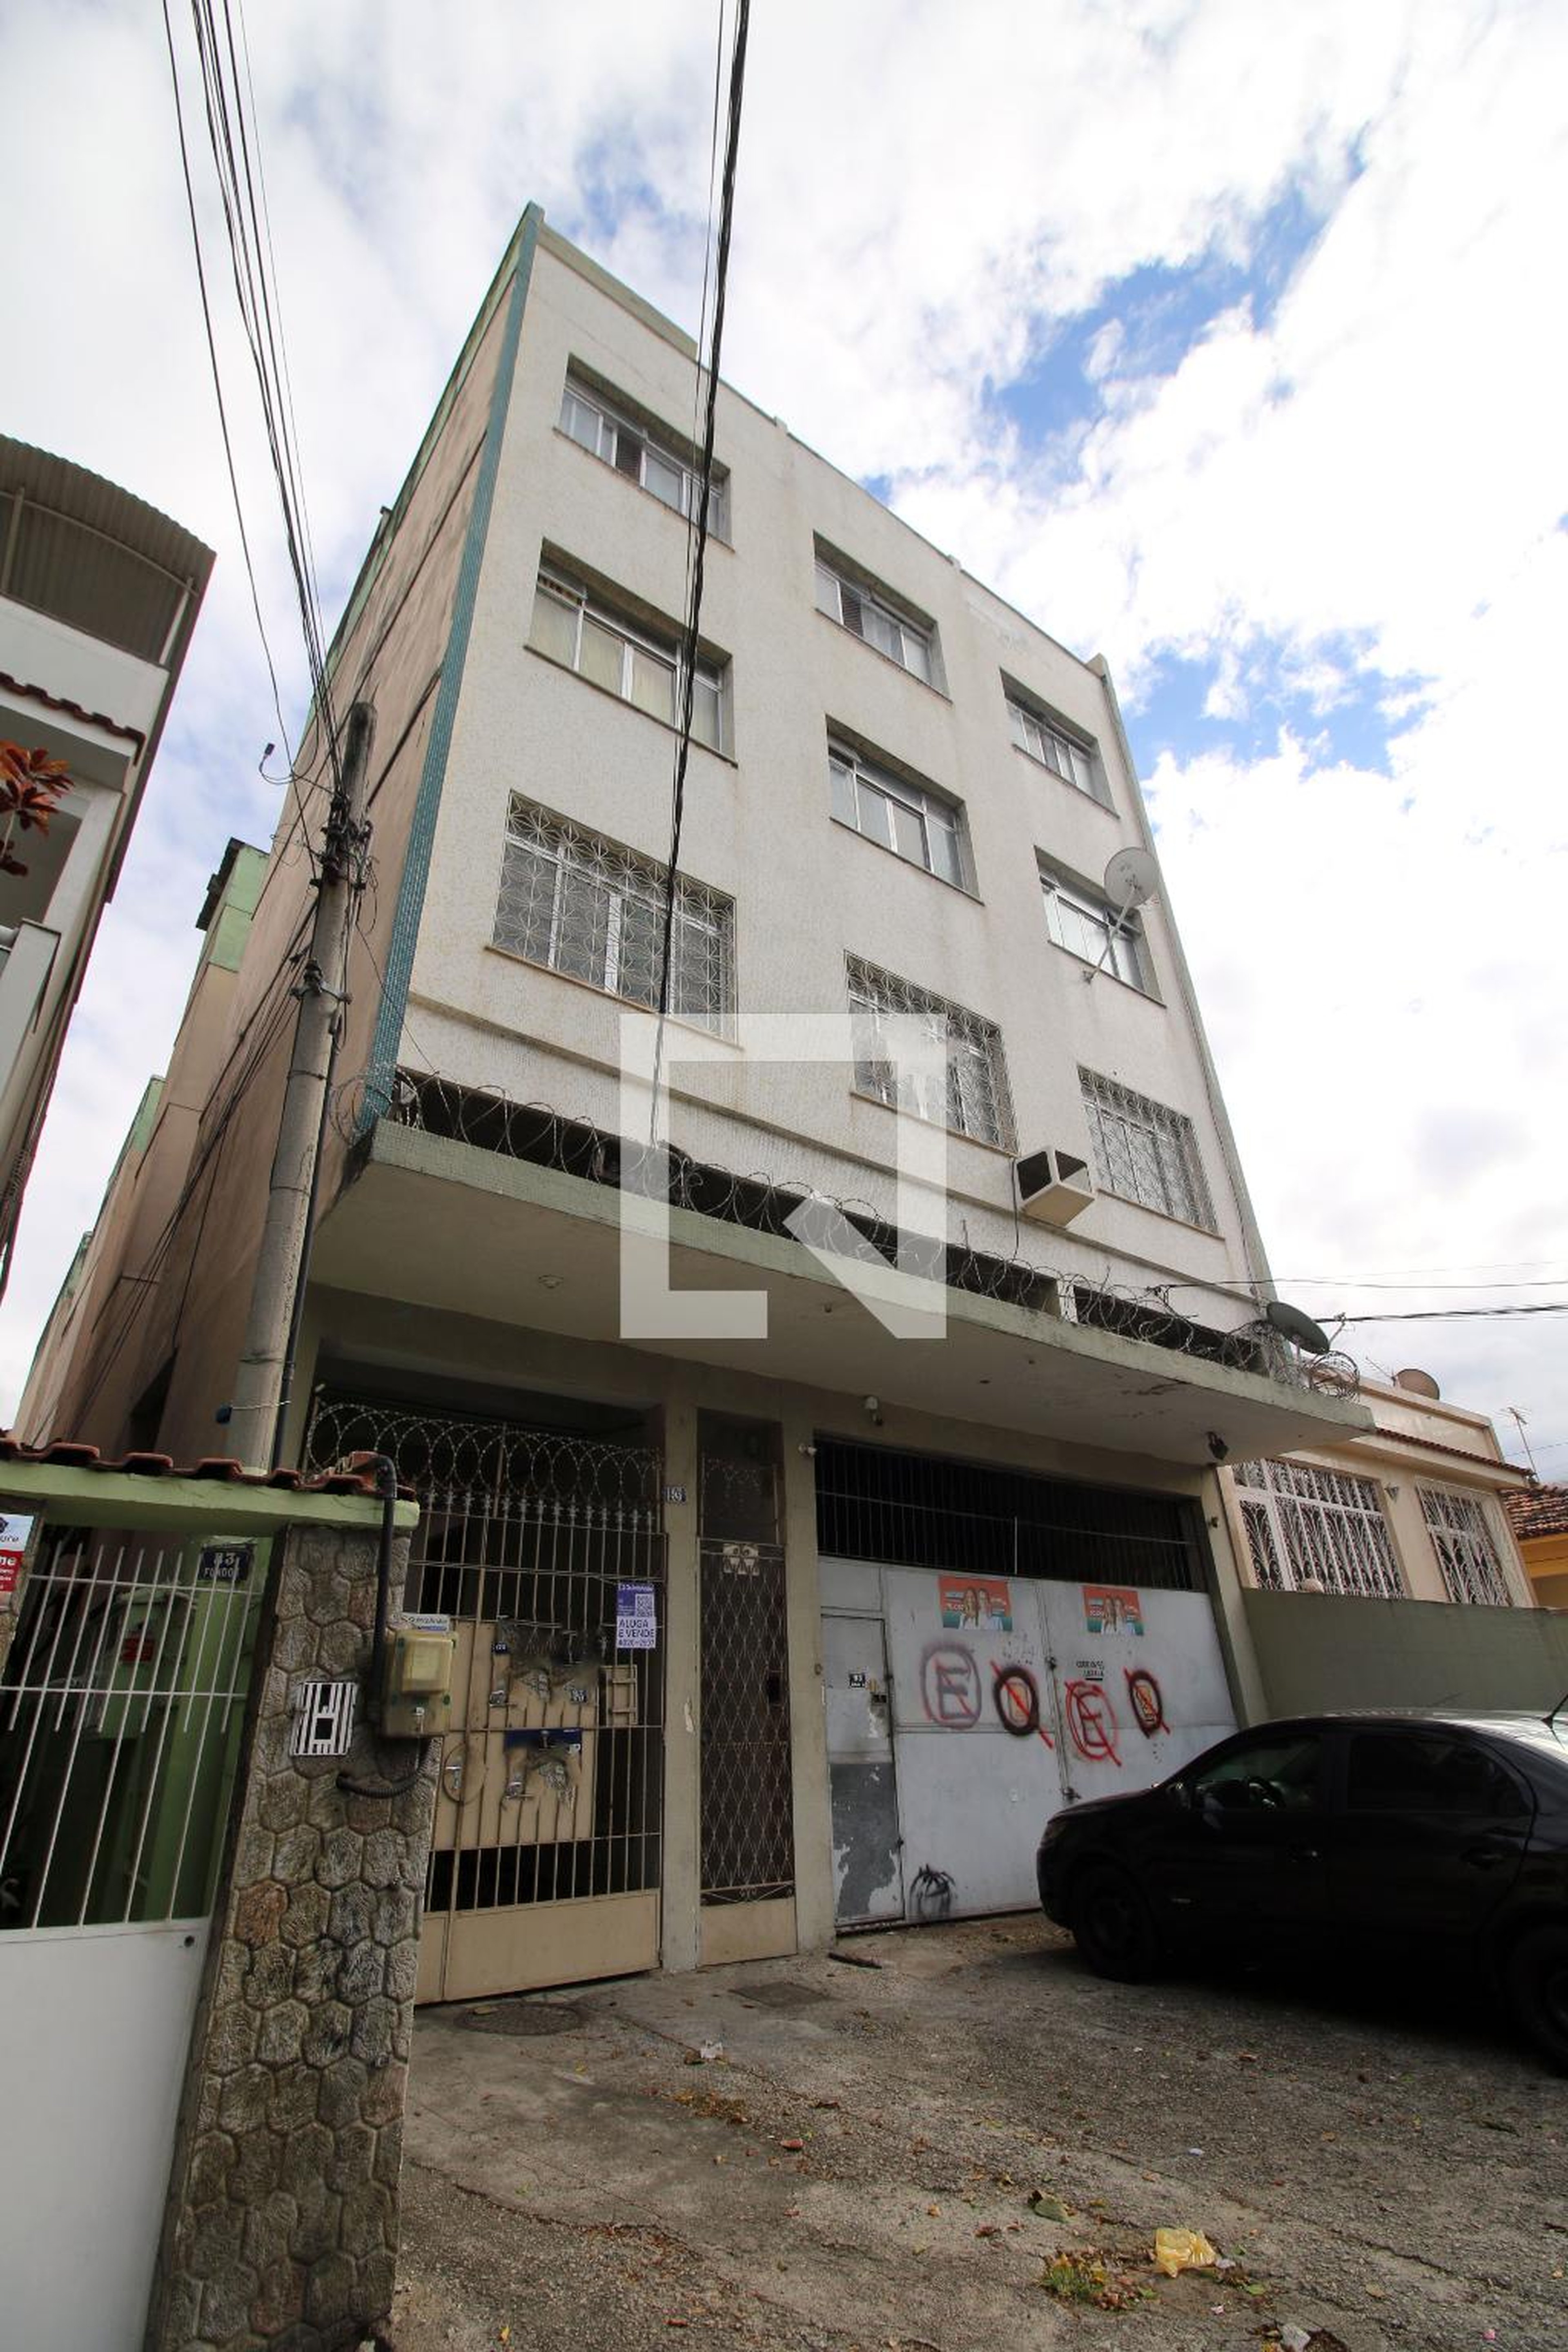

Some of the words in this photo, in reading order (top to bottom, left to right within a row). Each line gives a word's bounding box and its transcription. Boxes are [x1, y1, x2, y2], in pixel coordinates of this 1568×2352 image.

[619, 1619, 648, 1628] ALUGA
[619, 1629, 624, 1637] E
[626, 1629, 655, 1637] VENDE
